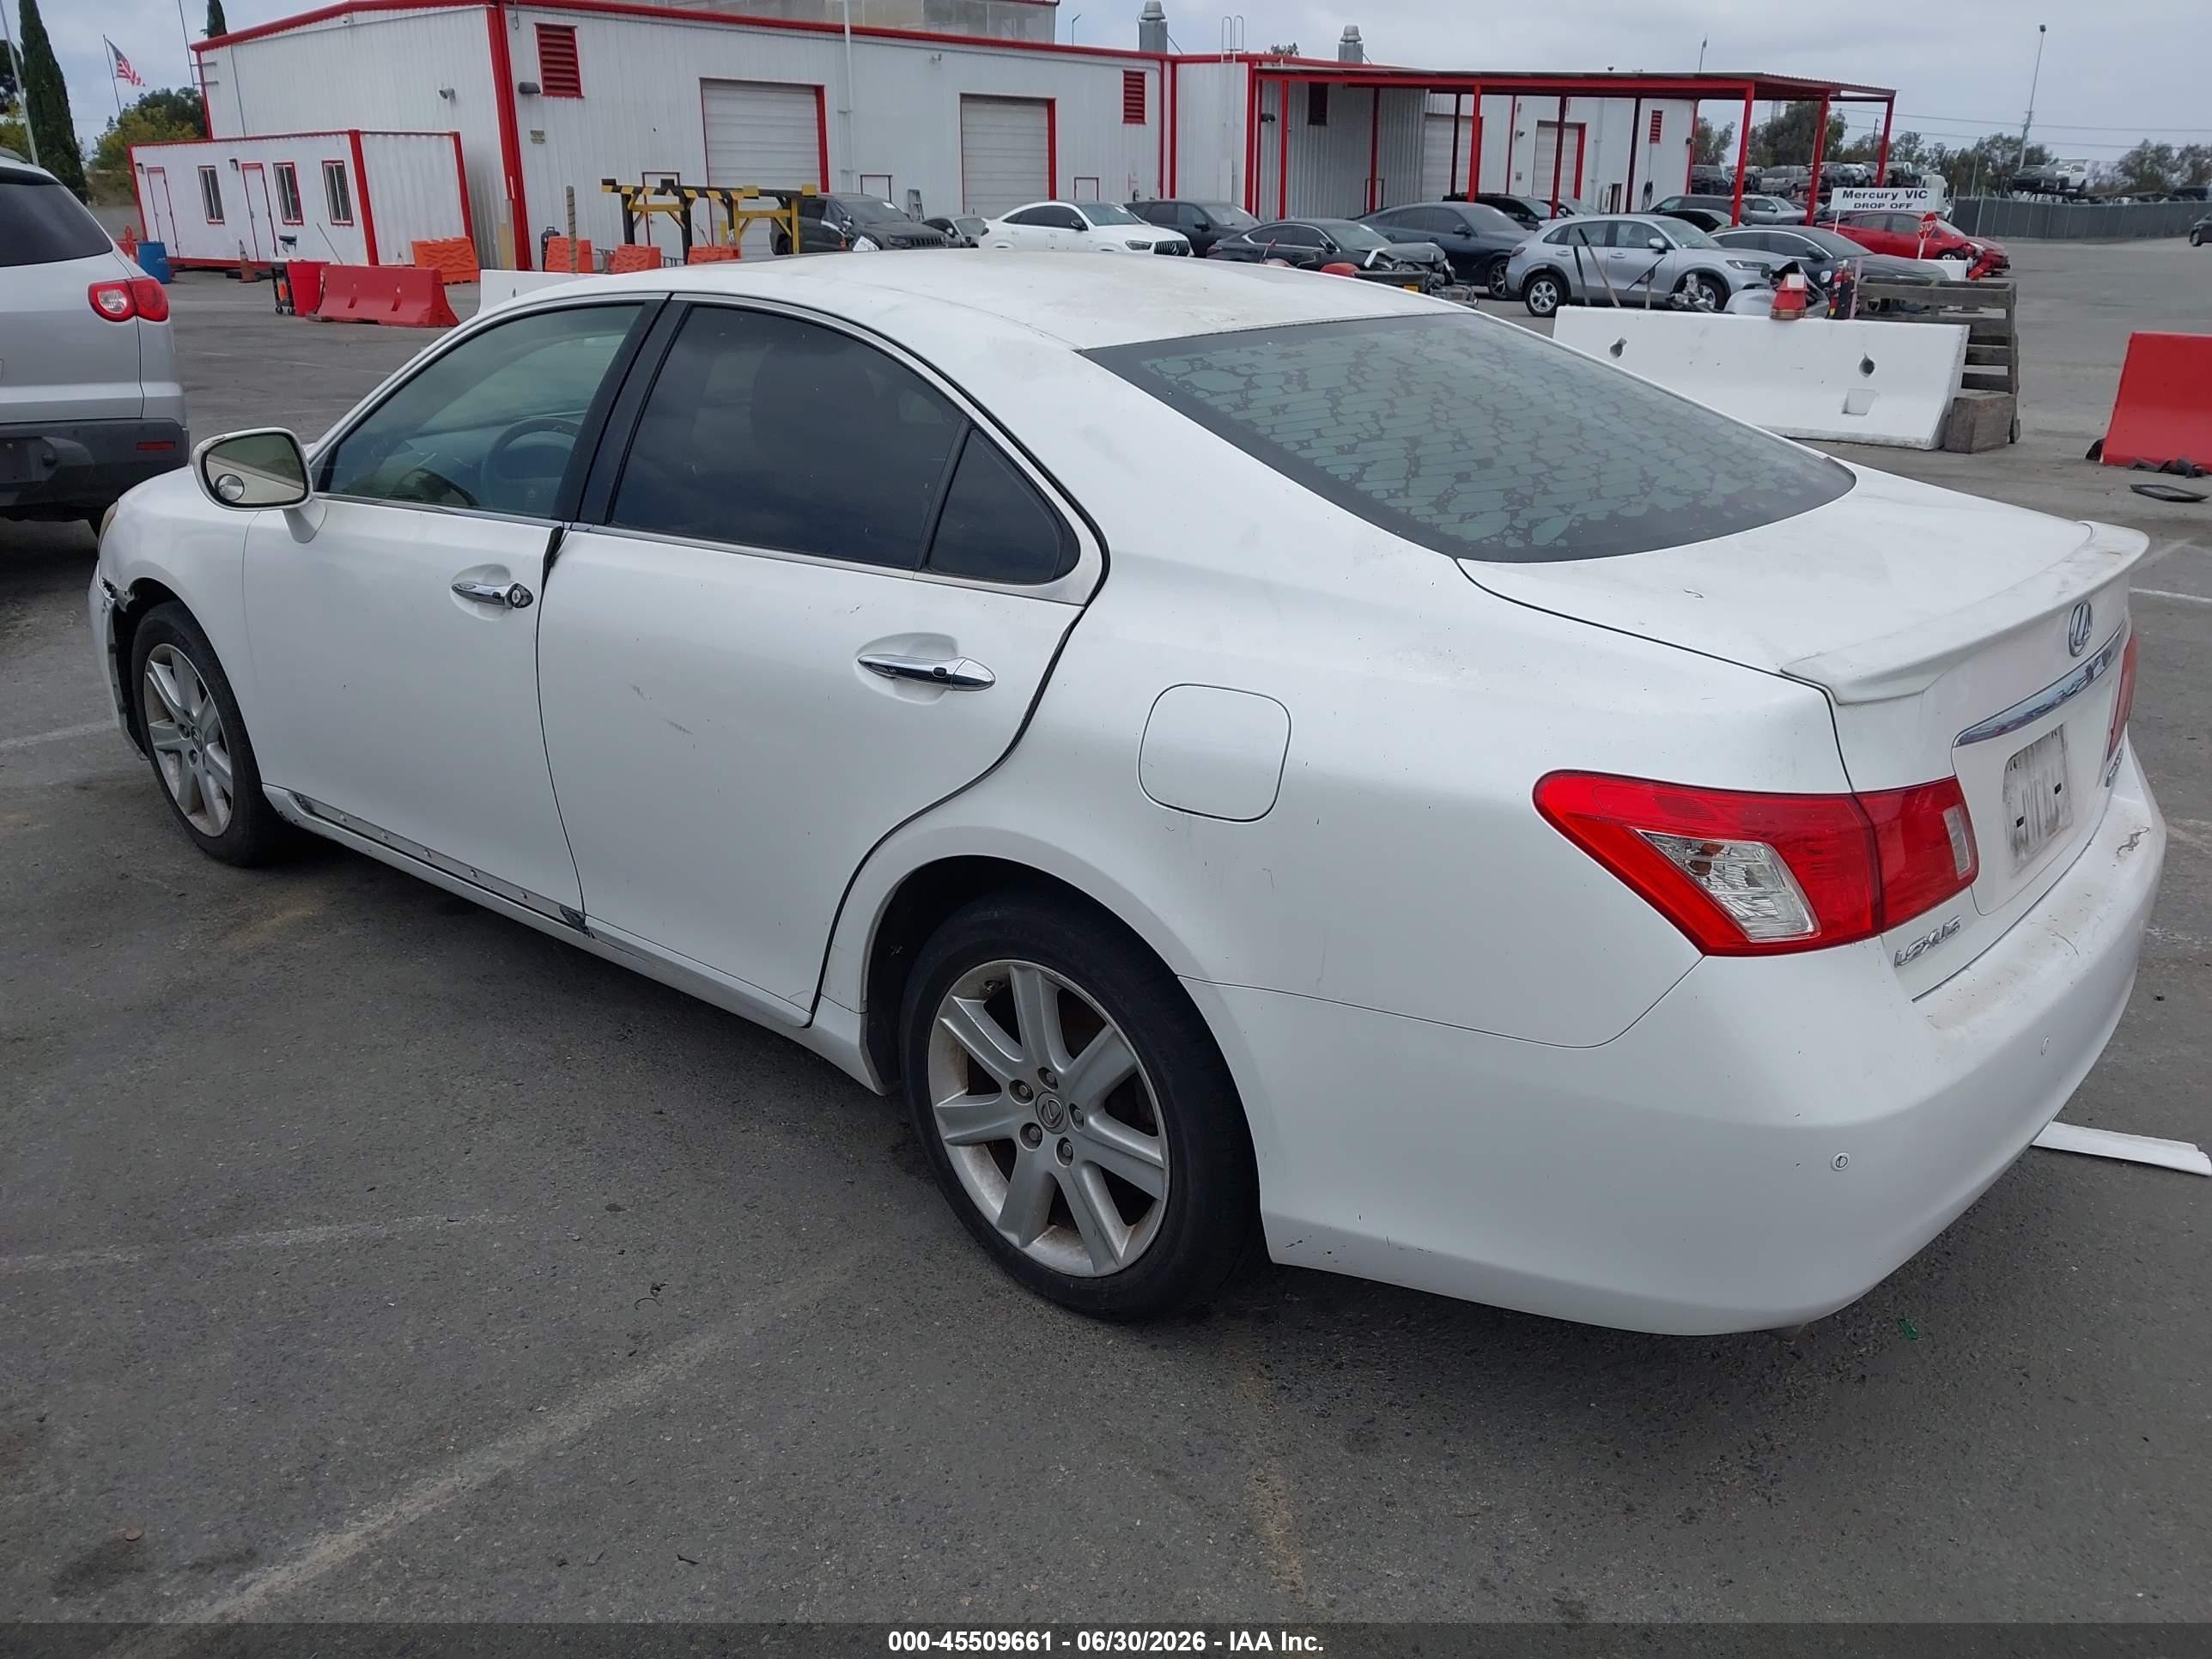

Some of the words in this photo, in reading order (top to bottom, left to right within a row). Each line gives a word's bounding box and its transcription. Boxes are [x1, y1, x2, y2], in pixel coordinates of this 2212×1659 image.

[1842, 190, 1899, 200] Mercury
[1905, 190, 1929, 198] VIC
[1919, 221, 1936, 233] STOP
[1893, 915, 1961, 968] LEXUS
